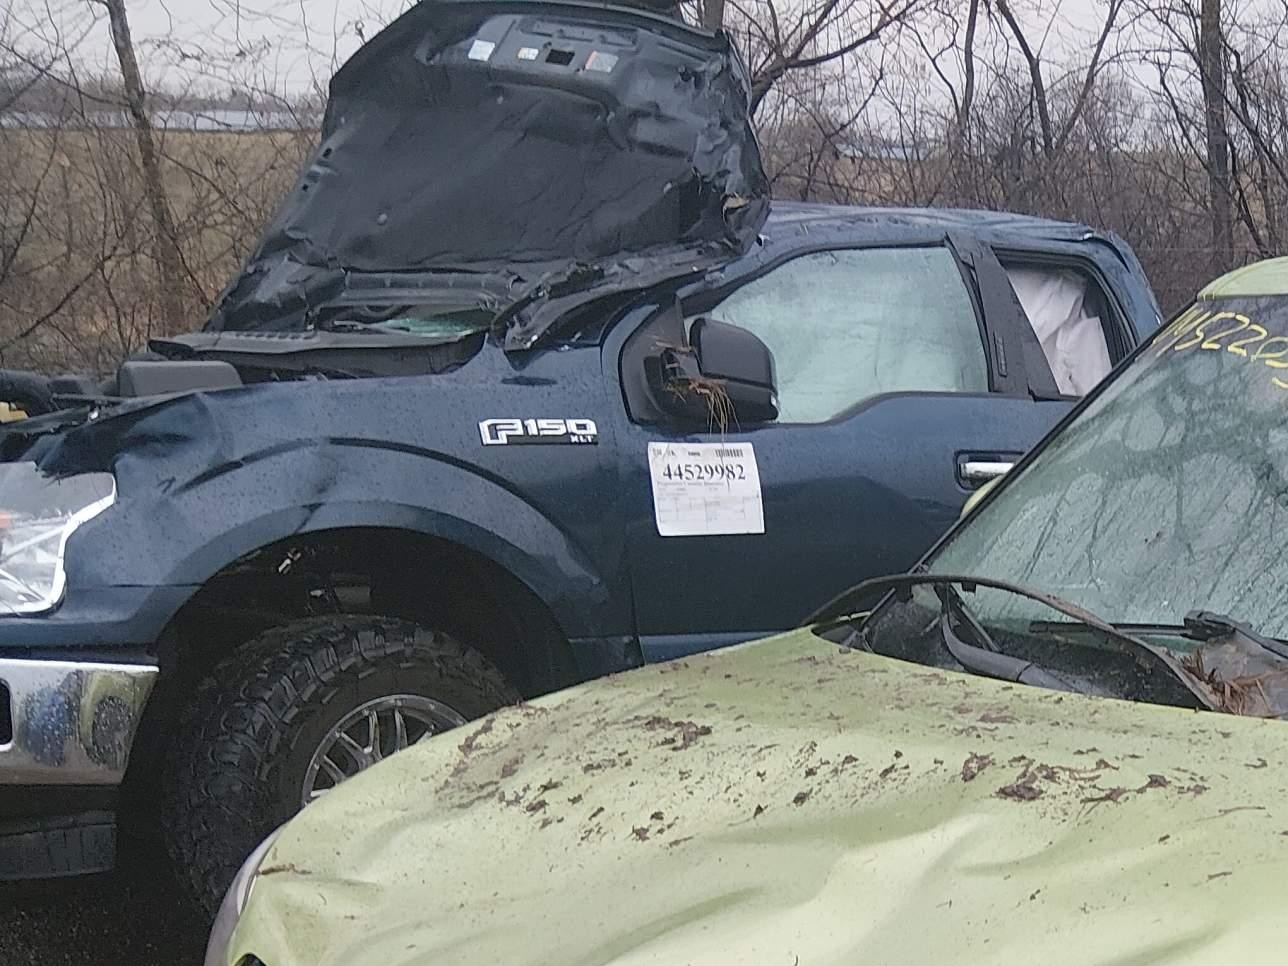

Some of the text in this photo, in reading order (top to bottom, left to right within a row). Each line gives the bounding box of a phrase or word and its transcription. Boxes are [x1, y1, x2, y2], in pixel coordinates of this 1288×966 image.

[479, 418, 598, 445] F150
[570, 434, 594, 443] XLT
[663, 463, 746, 481] 44529982
